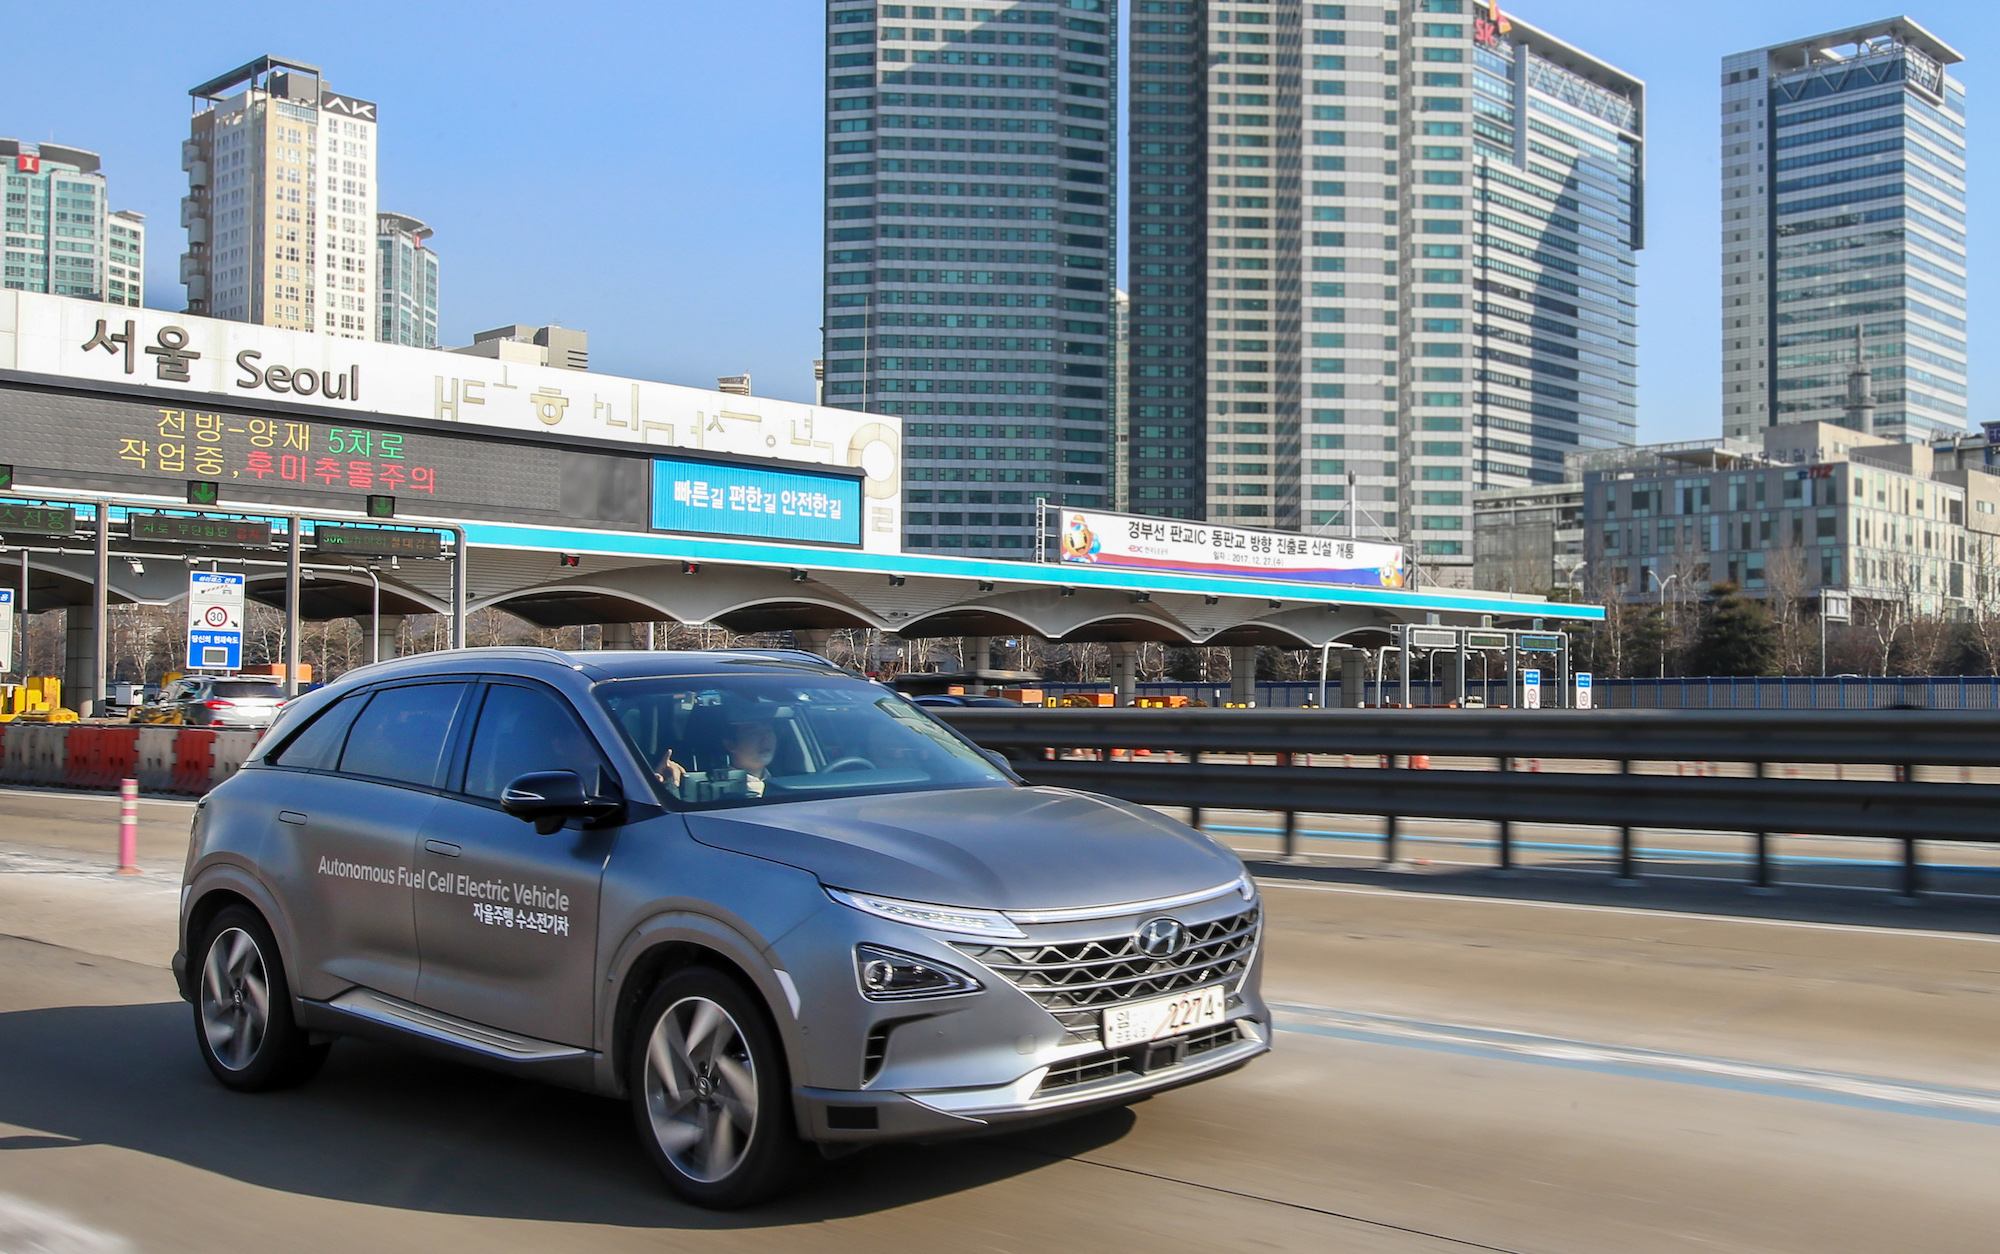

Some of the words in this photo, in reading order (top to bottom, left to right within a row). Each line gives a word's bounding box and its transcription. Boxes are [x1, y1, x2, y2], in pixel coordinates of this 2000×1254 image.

[1475, 18, 1496, 46] SK
[325, 97, 375, 119] AK
[82, 318, 201, 382] 서울
[236, 349, 360, 400] Seoul
[157, 409, 310, 452] 전방-양재
[328, 428, 405, 459] 5차로
[1809, 464, 1833, 479] 112
[674, 479, 724, 509] 빠른길
[728, 485, 777, 514] 편한길
[780, 490, 842, 520] 안전한길
[1128, 521, 1165, 542] 경부선
[1170, 526, 1207, 545] 판교IC
[1211, 530, 1246, 549] 동판교
[1250, 535, 1272, 553] 방향
[1276, 538, 1308, 555] 진출로
[1311, 540, 1332, 557] 신설
[1335, 542, 1355, 560] 개통
[1213, 551, 1225, 560] 일자
[209, 611, 223, 622] 30
[191, 635, 211, 644] 당신의
[318, 855, 395, 885] Autonomous
[398, 866, 425, 890] Fuel
[428, 871, 454, 894] Cell
[456, 875, 510, 902] Electric
[513, 883, 570, 912] Vehicle
[473, 902, 514, 928] 자율주행
[515, 911, 570, 937] 수소전기차
[1168, 994, 1216, 1029] 2274
